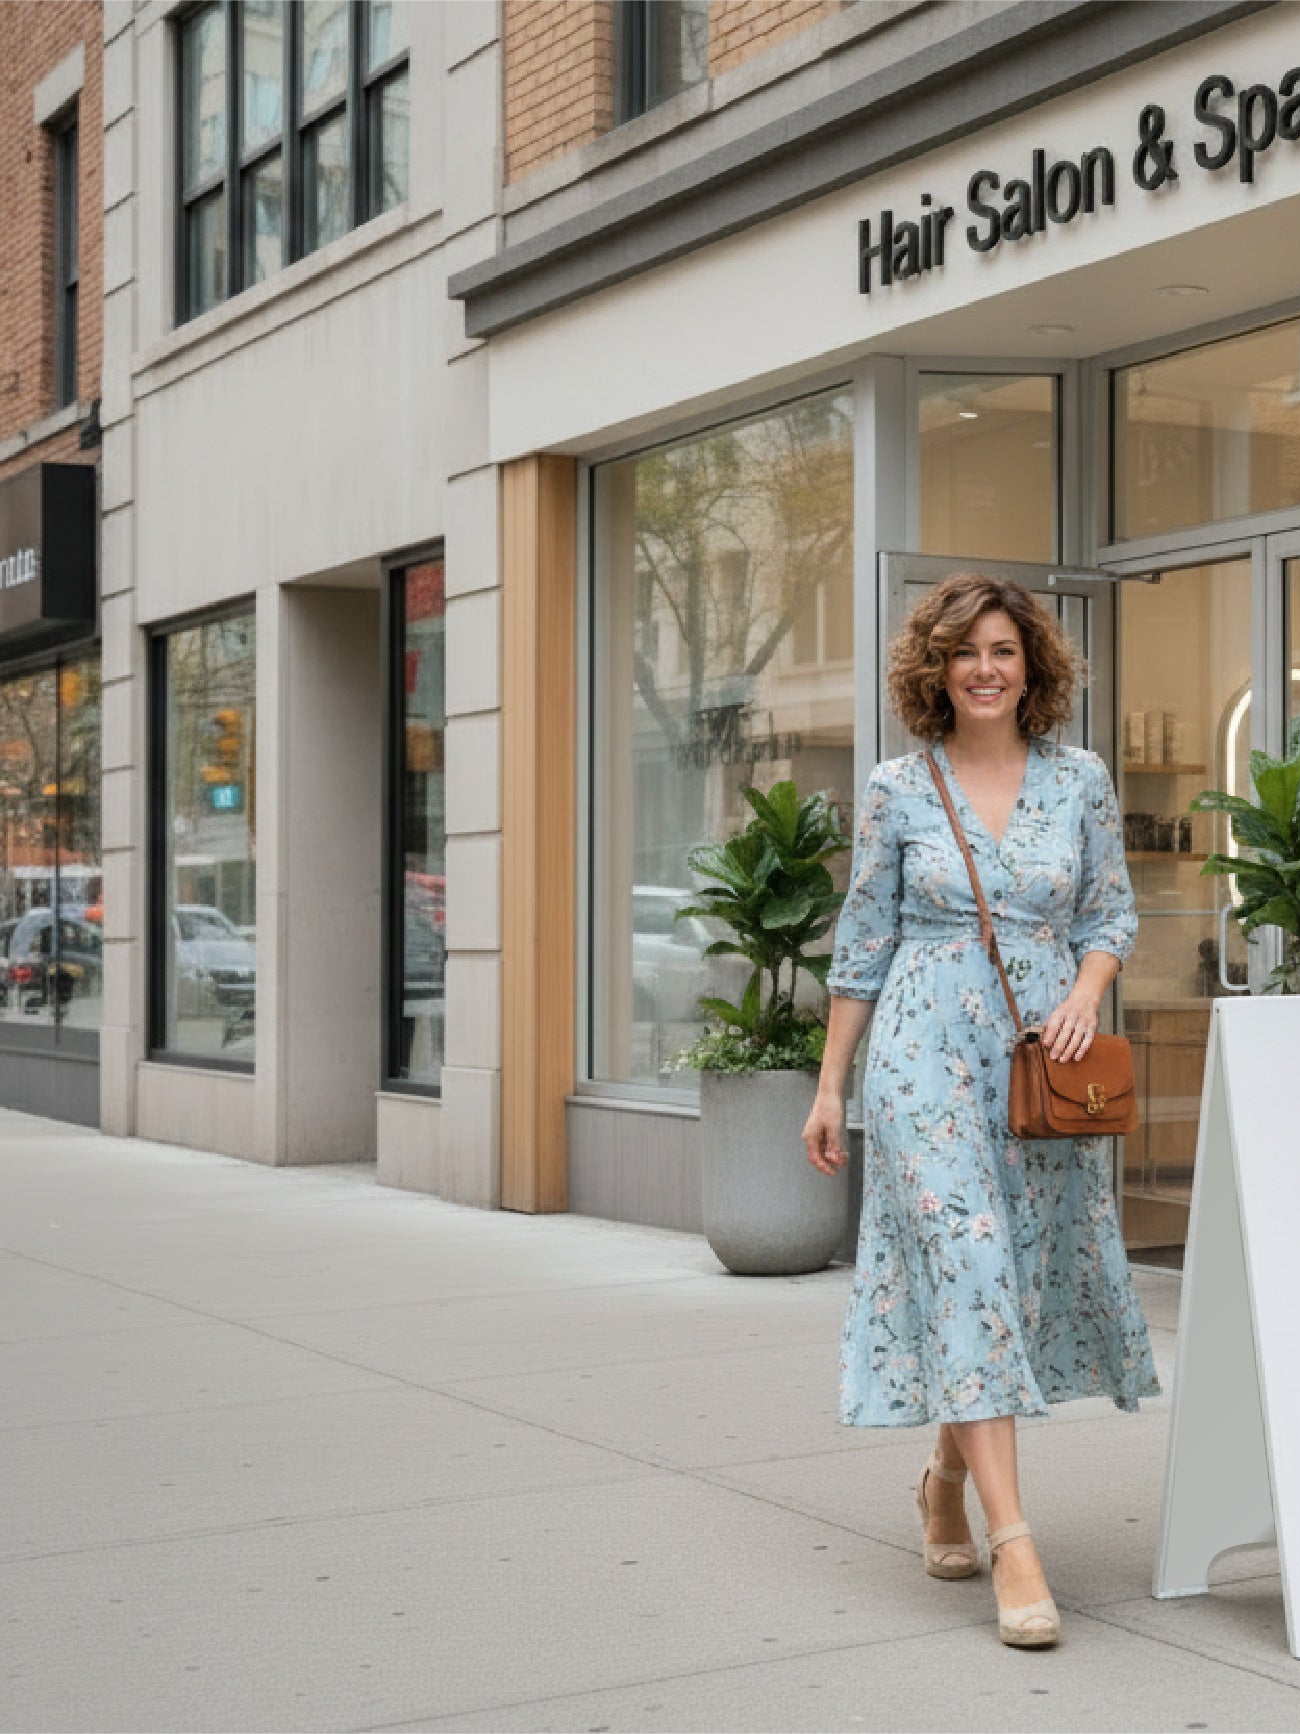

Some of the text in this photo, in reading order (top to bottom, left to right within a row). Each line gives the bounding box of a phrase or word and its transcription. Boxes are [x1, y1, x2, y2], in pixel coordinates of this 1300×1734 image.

[858, 193, 954, 294] Hair
[967, 148, 1115, 252] Salon
[1133, 104, 1179, 190] &
